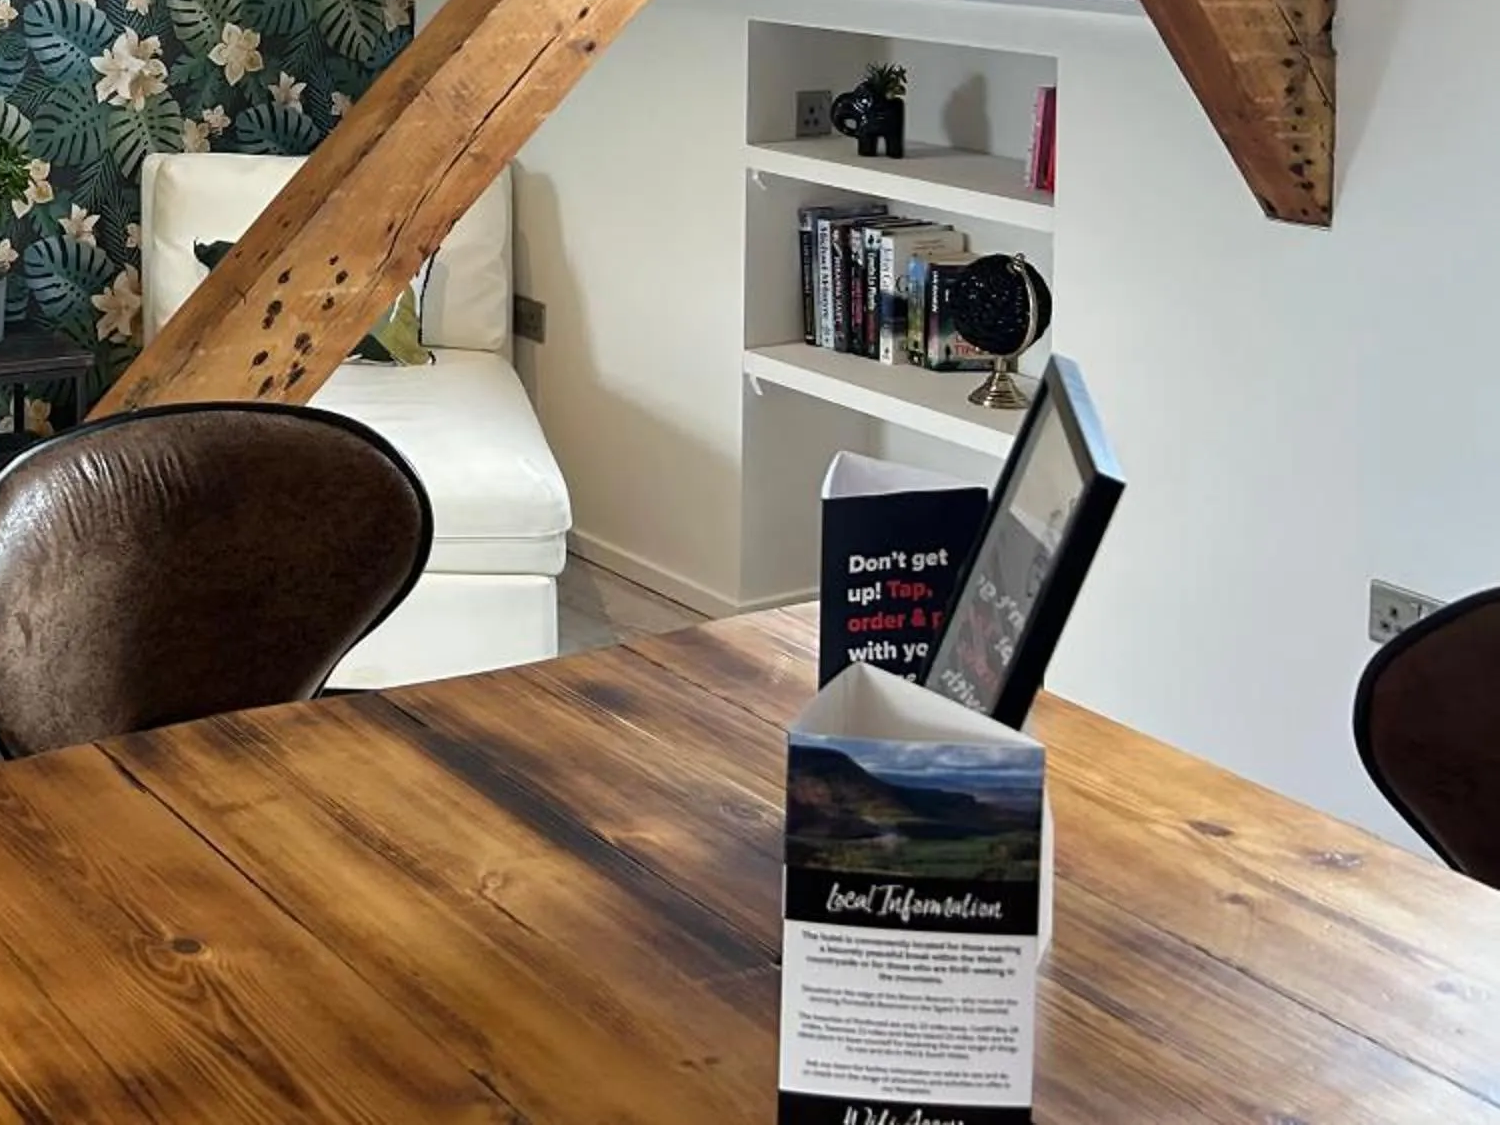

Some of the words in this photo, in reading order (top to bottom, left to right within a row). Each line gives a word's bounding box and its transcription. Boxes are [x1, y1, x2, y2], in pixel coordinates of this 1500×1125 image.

[848, 550, 906, 574] Don't
[911, 548, 948, 572] get
[847, 581, 882, 606] up!
[886, 579, 933, 601] Tap,
[847, 611, 906, 632] order
[848, 640, 898, 662] with
[902, 642, 929, 663] yo
[826, 881, 876, 914] Local
[876, 884, 1004, 923] Information
